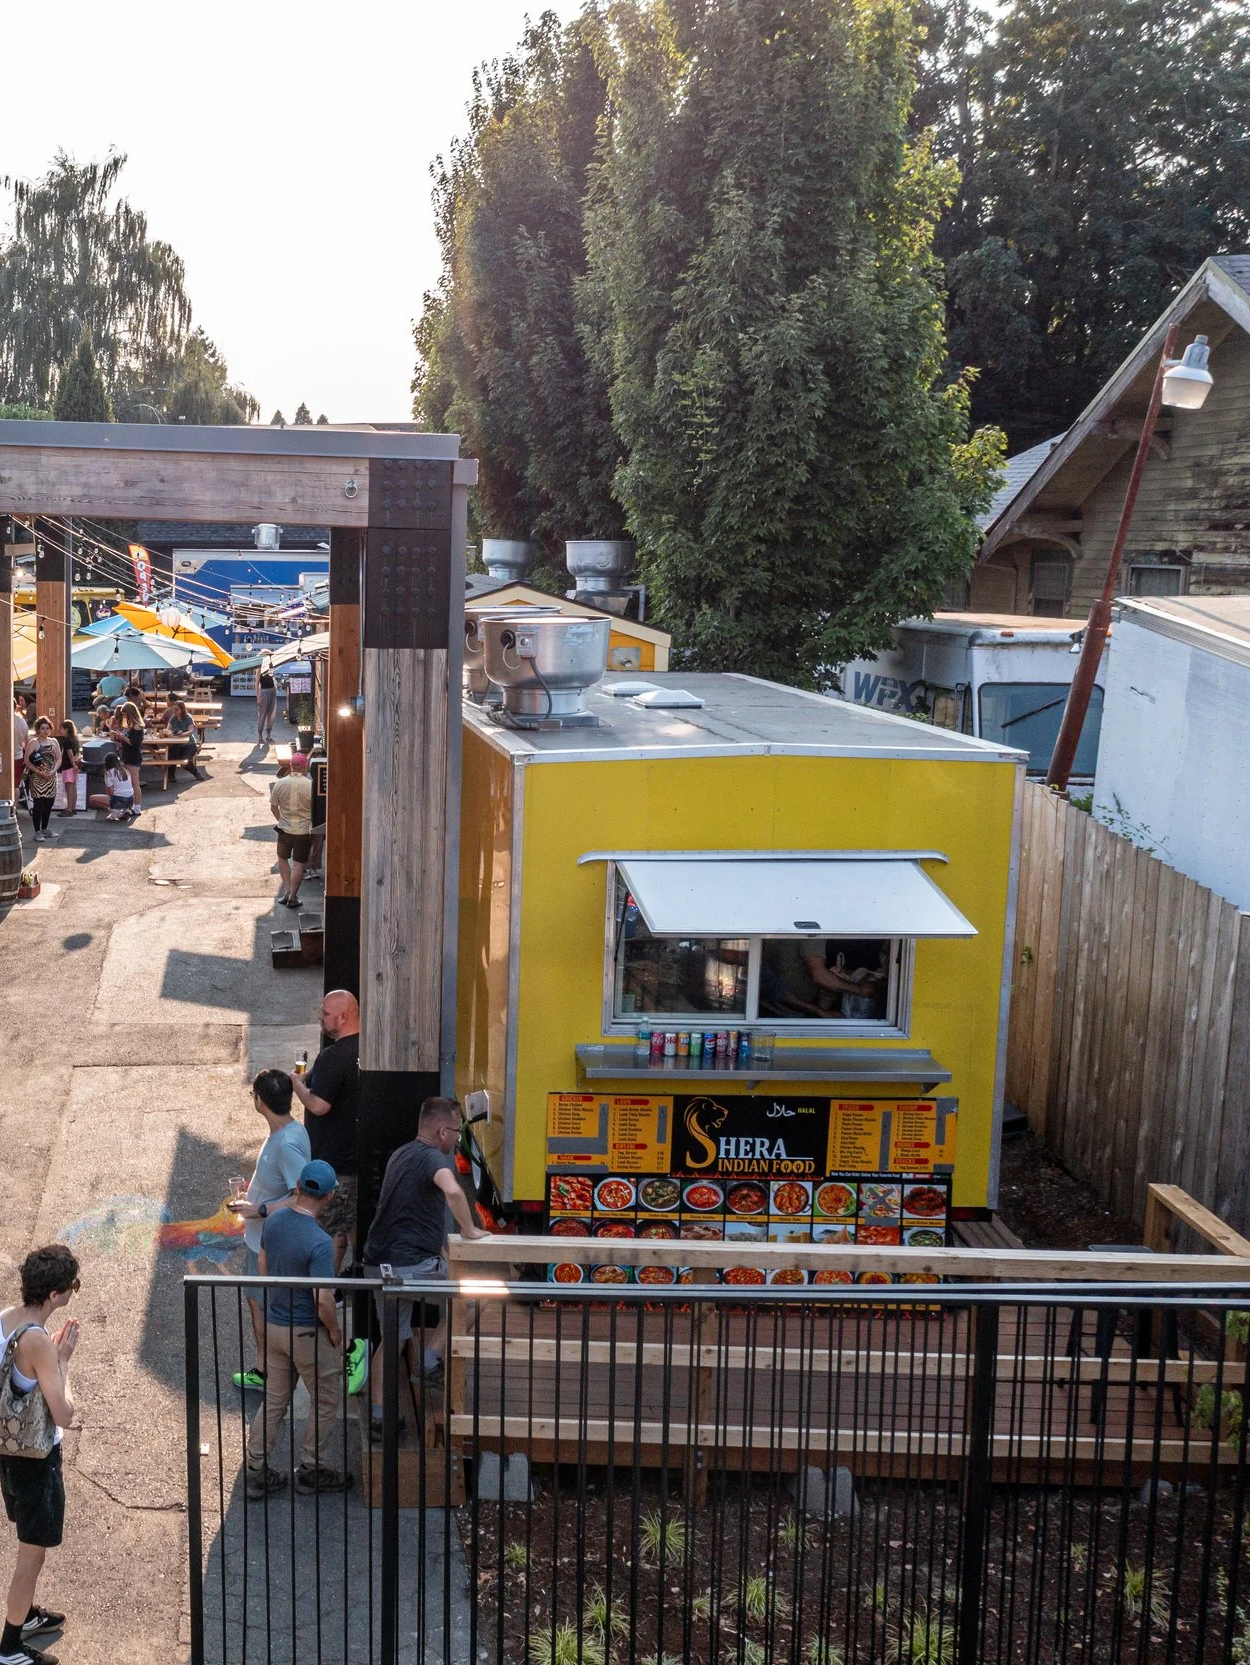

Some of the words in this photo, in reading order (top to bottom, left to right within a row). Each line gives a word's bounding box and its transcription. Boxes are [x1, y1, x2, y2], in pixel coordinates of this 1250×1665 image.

[766, 1102, 796, 1117] حلال
[684, 1096, 790, 1168] SHERA
[718, 1160, 769, 1172] INDIAN
[772, 1160, 815, 1173] FOOD
